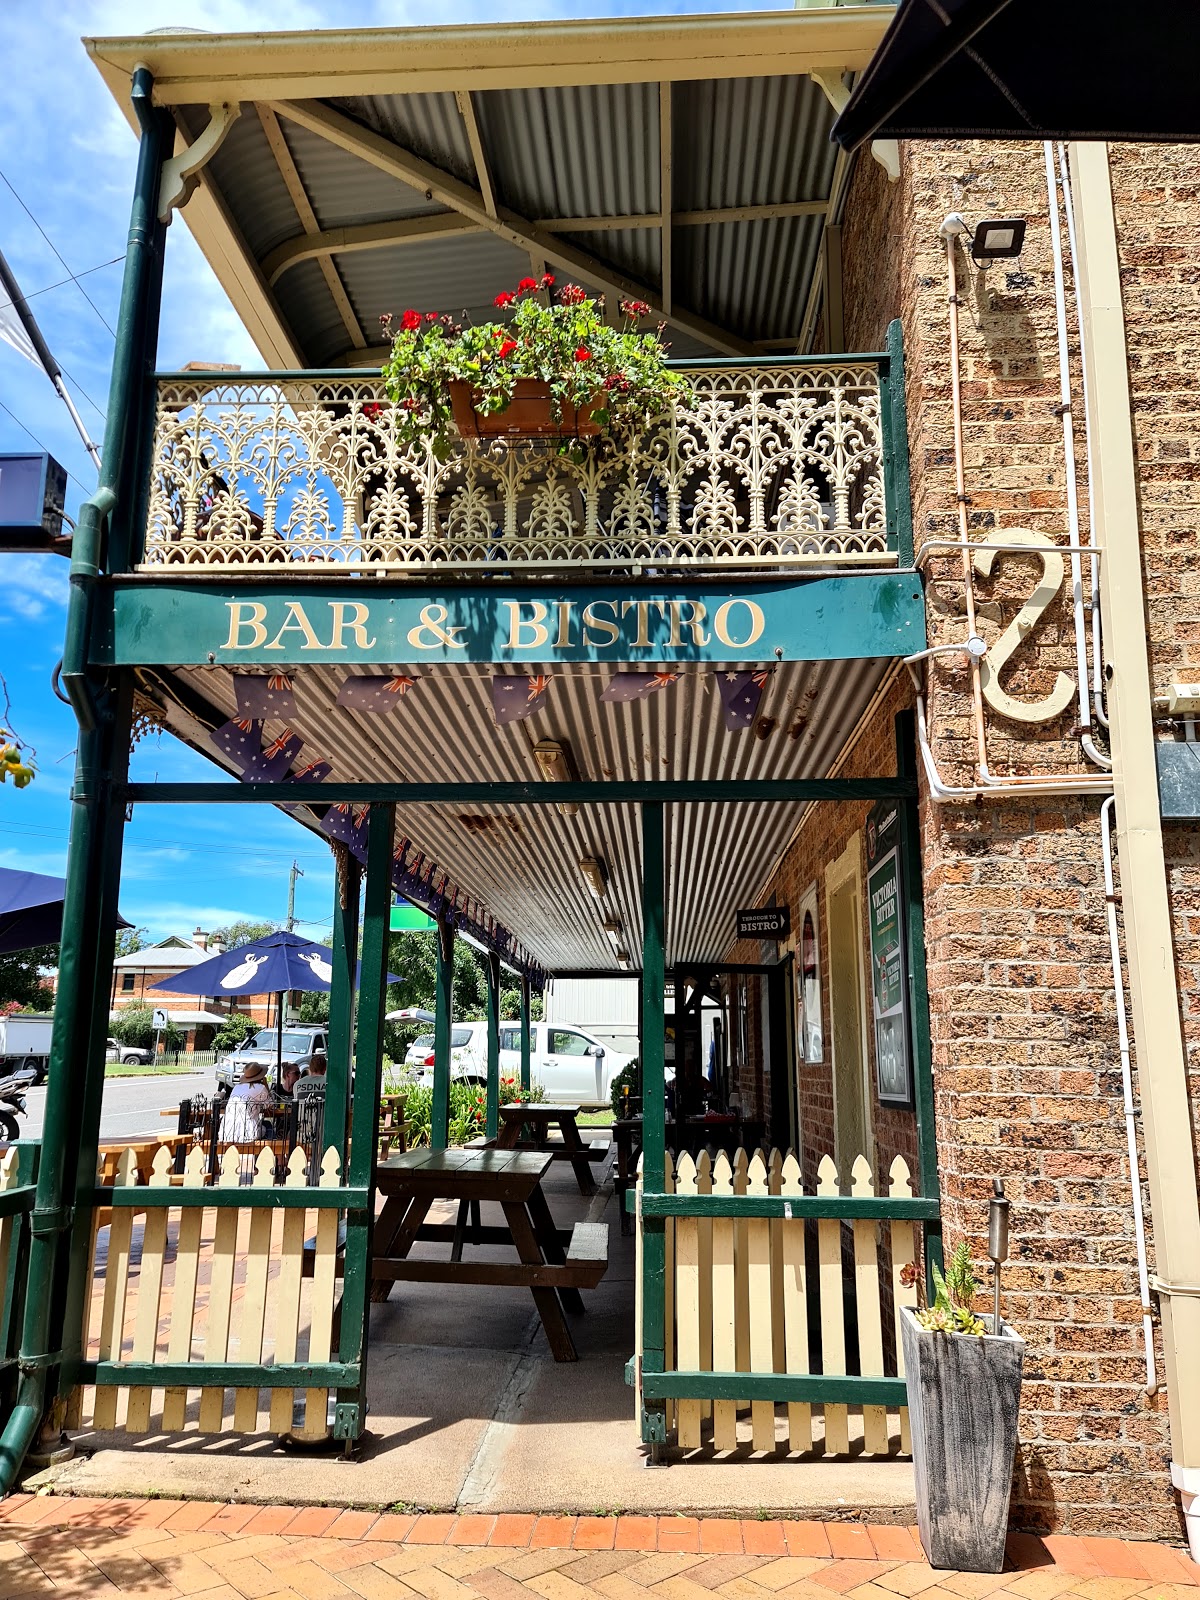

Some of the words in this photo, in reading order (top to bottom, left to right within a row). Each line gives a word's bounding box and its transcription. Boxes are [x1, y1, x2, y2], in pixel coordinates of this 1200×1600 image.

[219, 602, 377, 649] BAR
[407, 604, 469, 649] &
[500, 599, 766, 648] BISTRO
[872, 876, 898, 910] VICTORIA
[740, 921, 779, 932] BISTRO
[876, 897, 896, 926] BITTER
